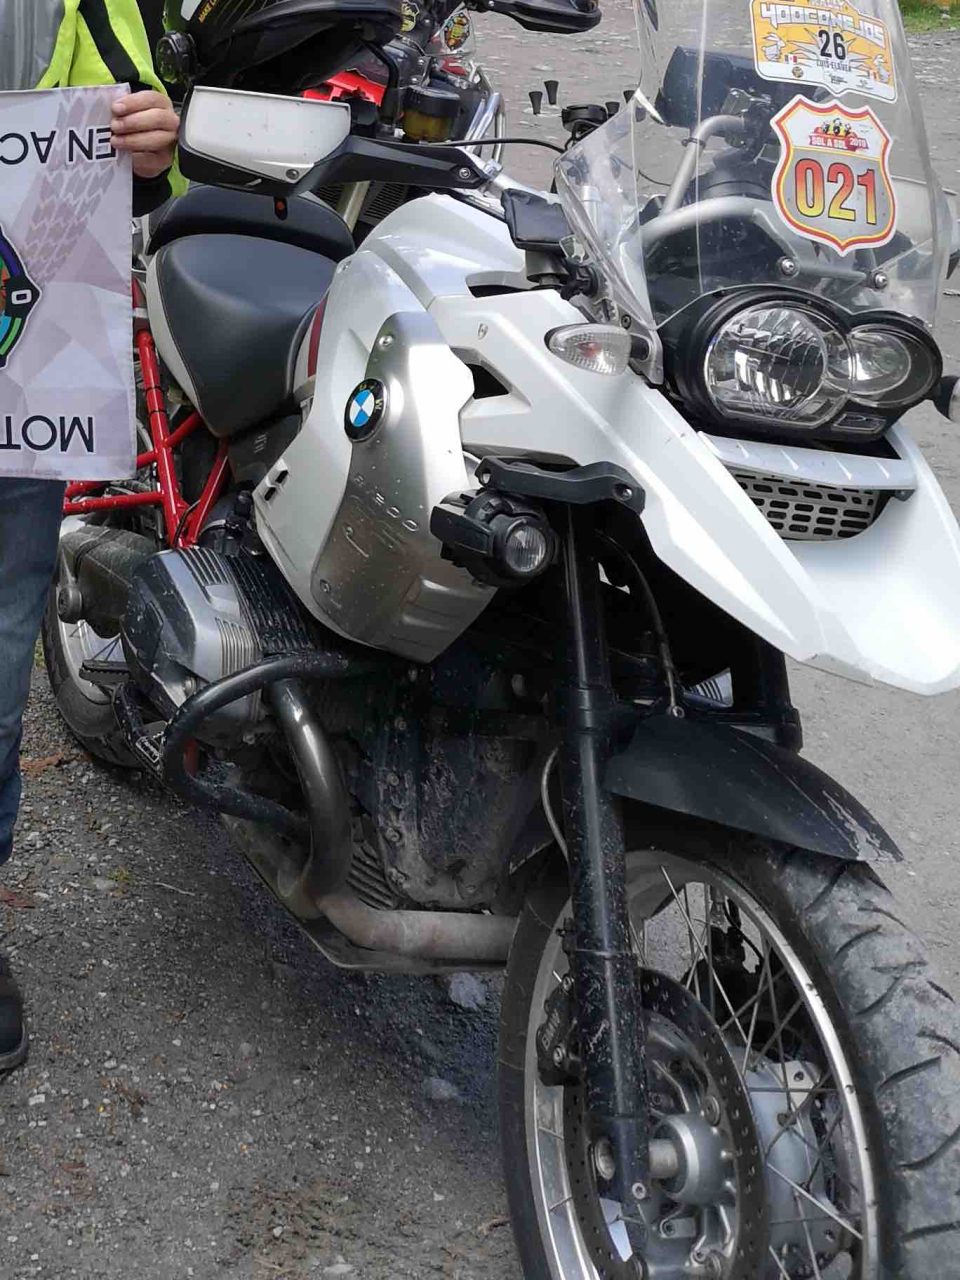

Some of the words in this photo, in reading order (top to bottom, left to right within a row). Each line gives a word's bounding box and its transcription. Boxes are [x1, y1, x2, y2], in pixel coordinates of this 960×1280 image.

[818, 29, 847, 61] 26
[68, 127, 117, 162] EN
[795, 158, 878, 225] 021
